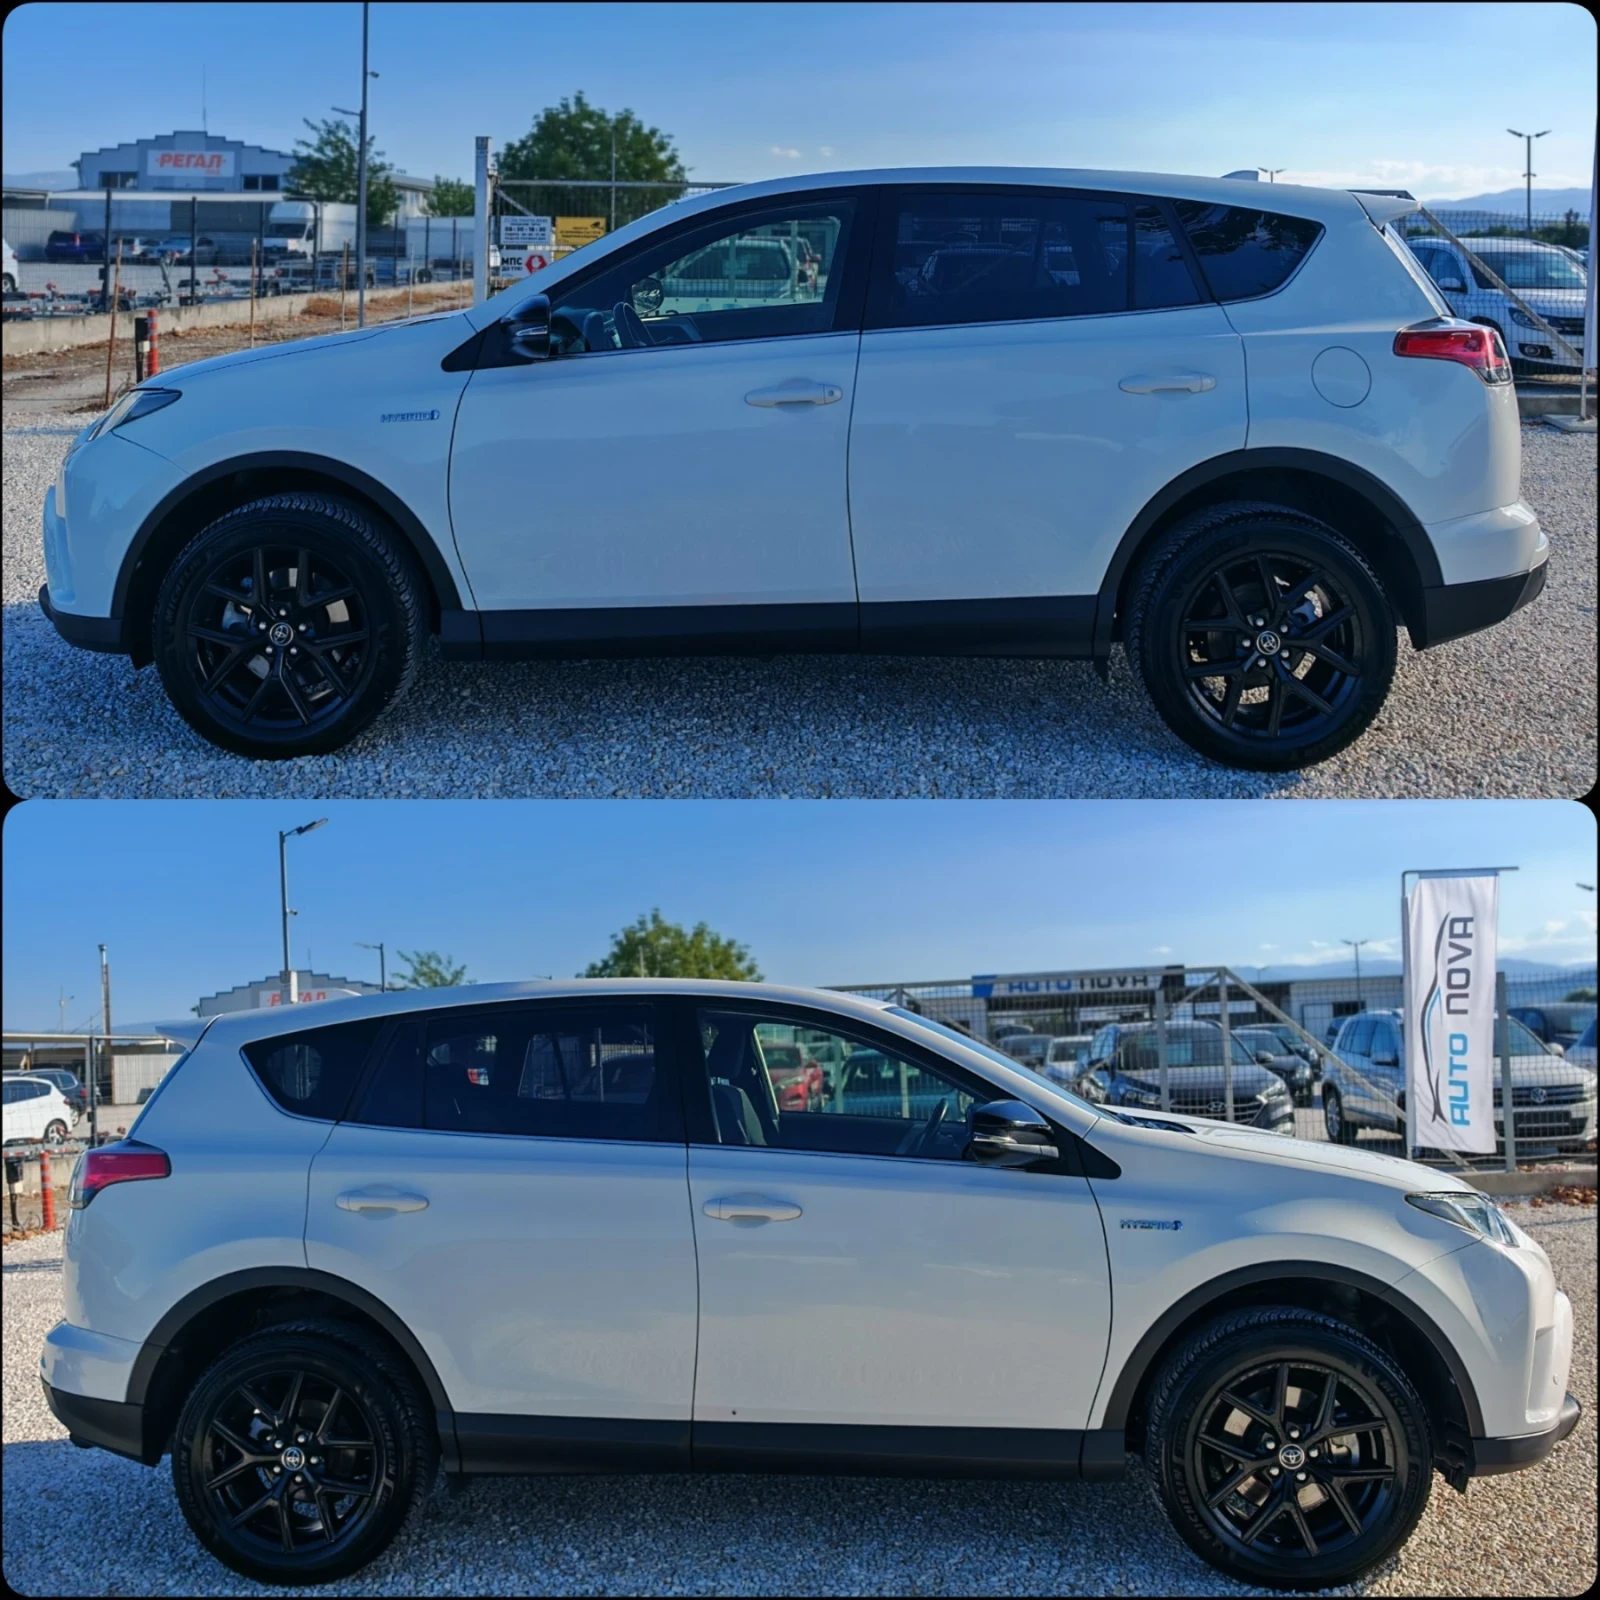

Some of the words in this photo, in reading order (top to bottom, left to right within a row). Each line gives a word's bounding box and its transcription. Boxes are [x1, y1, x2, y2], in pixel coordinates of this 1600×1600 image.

[159, 152, 222, 168] РЕГАЛ
[501, 257, 523, 265] МПС
[1446, 916, 1474, 1015] NOVA
[1448, 1033, 1471, 1126] AUTO
